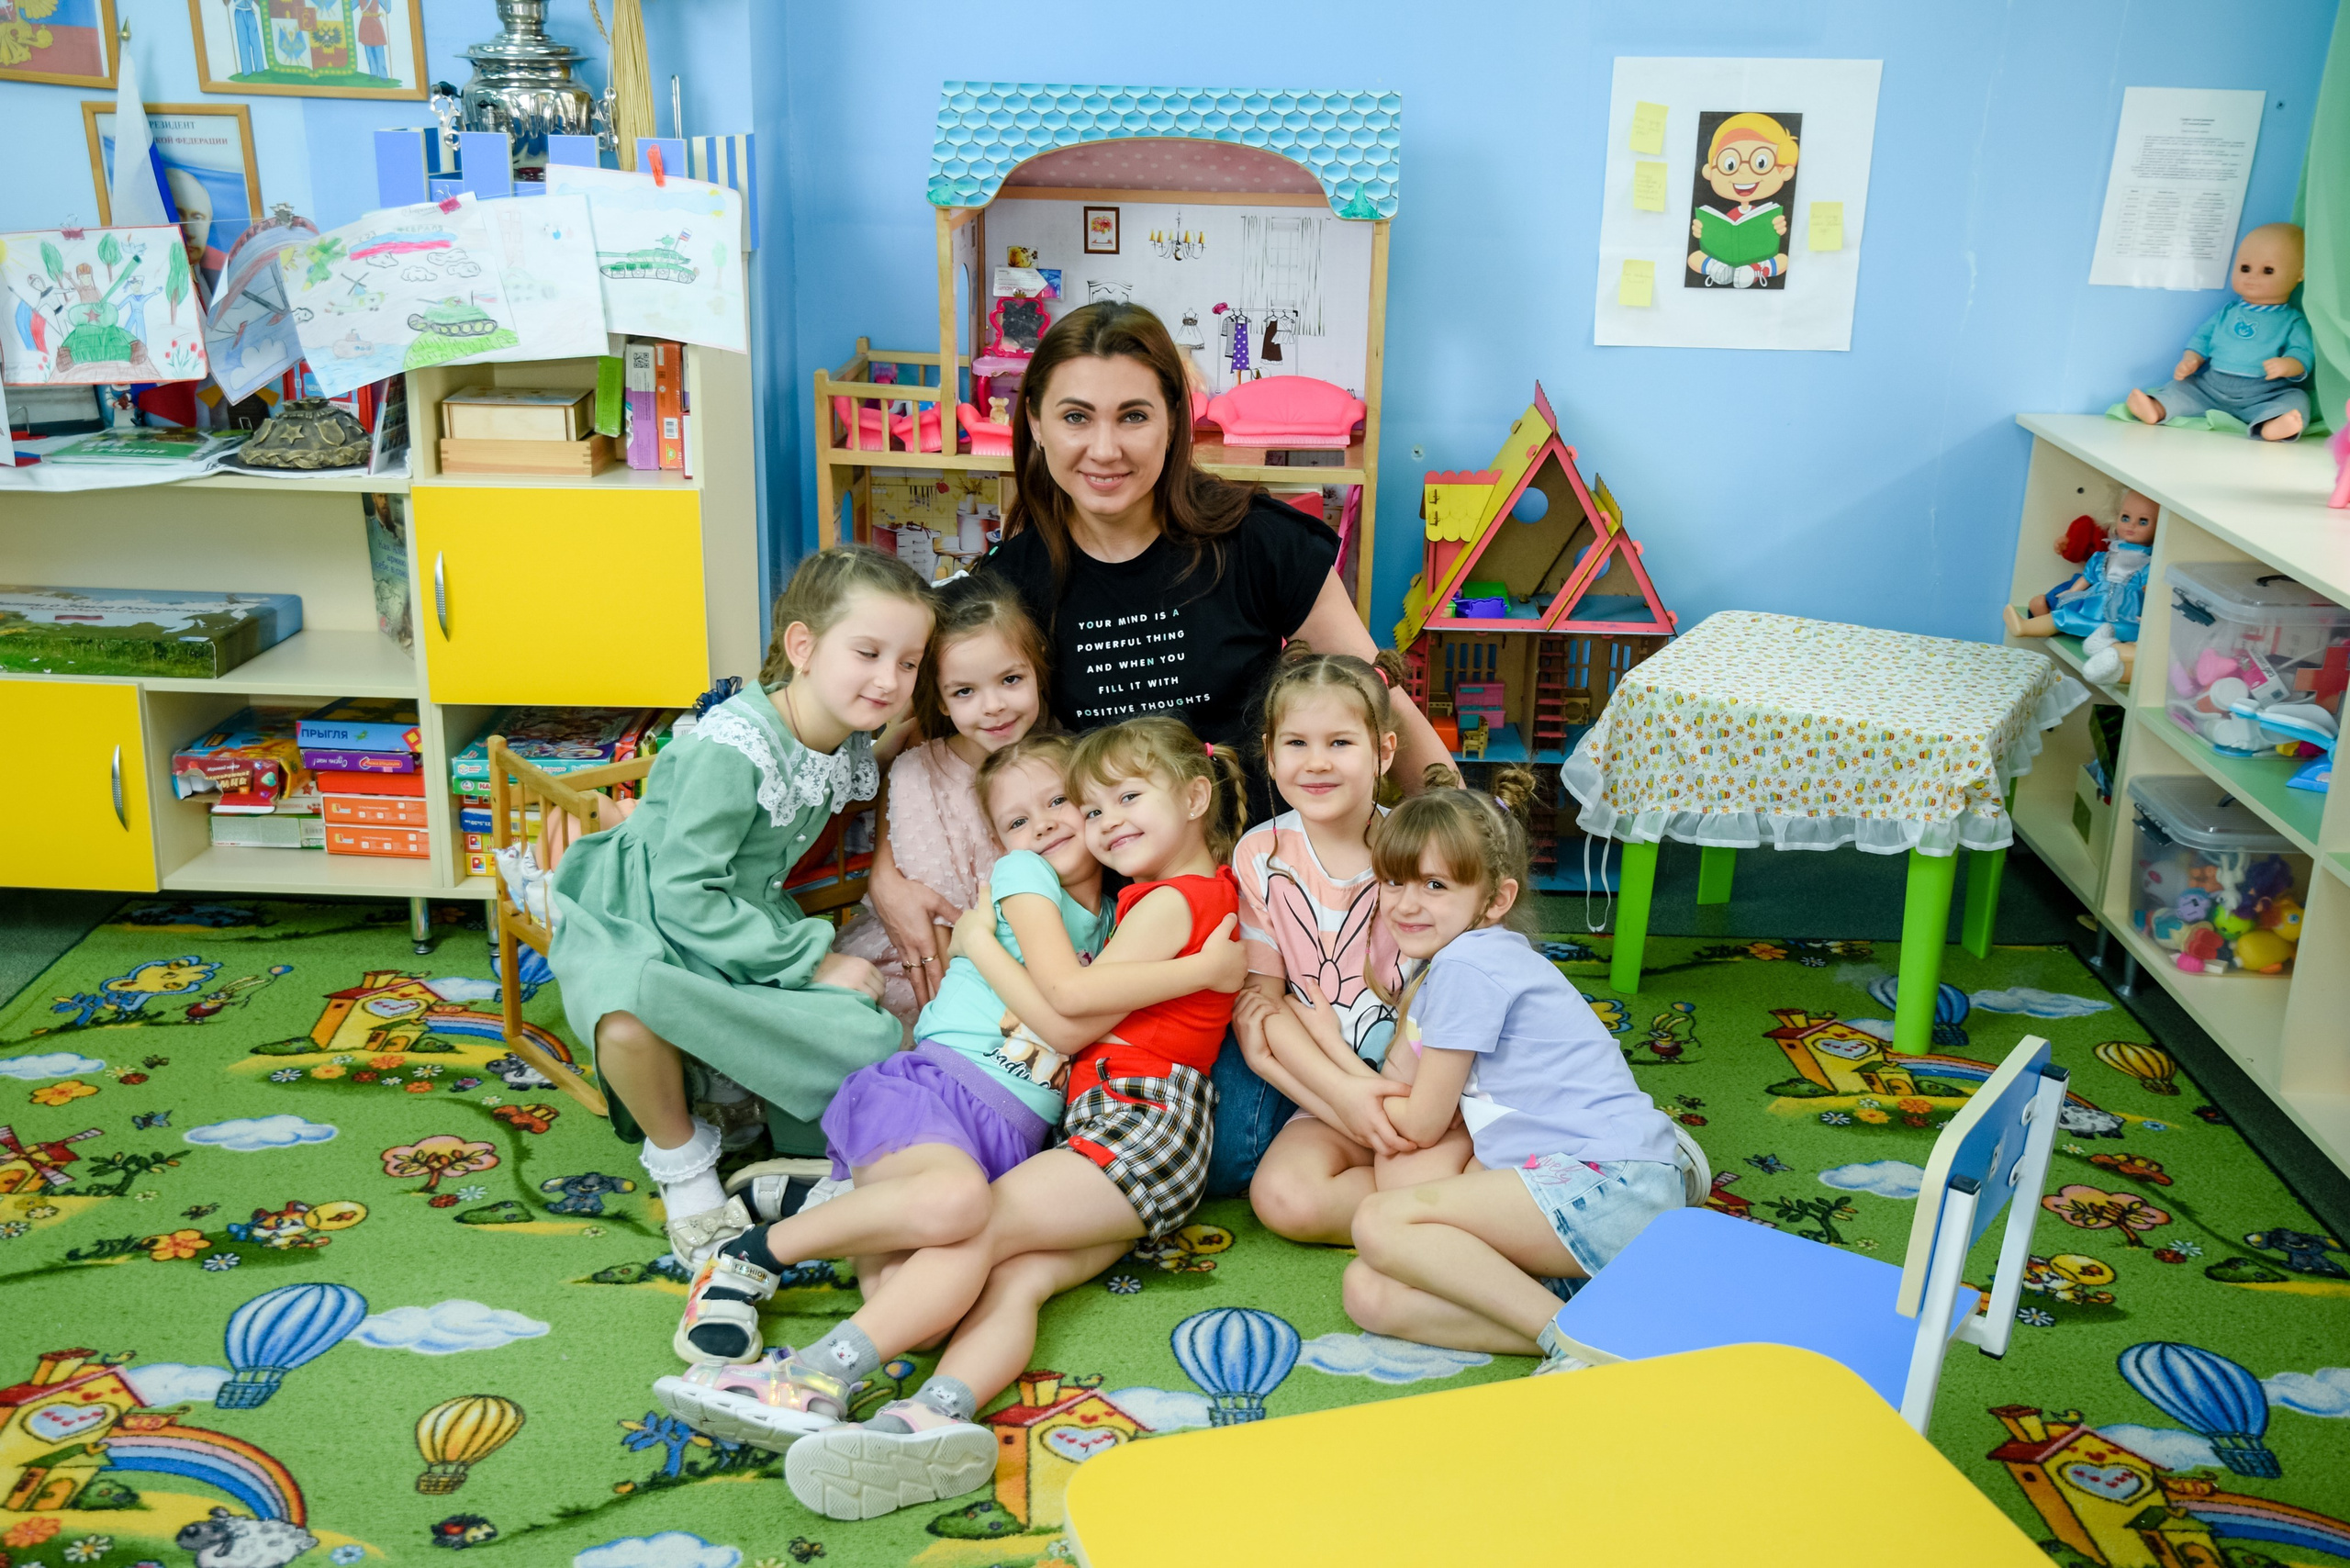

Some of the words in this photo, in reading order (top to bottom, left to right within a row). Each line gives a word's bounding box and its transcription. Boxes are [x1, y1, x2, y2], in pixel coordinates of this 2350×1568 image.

[149, 120, 196, 129] РЕЗИДЕНТ
[175, 136, 229, 145] ФЕДЕРАЦИИ
[1079, 620, 1112, 631] YOUR
[1118, 614, 1147, 626] MIND
[1155, 611, 1166, 621] IS
[1172, 609, 1180, 617] A
[1077, 637, 1142, 653] POWERFUL
[1147, 630, 1185, 644] THING
[1087, 663, 1113, 674] AND
[1119, 657, 1154, 669] WHEN
[1160, 653, 1185, 665] YOU
[1098, 684, 1124, 695] FILL
[1130, 681, 1141, 690] IT
[1147, 677, 1179, 689] WITH
[1076, 704, 1135, 718] POSITIVE
[1141, 693, 1211, 711] THOUGHTS
[301, 728, 348, 739] ПРЫГЛЯ
[734, 1263, 768, 1281] FASHION
